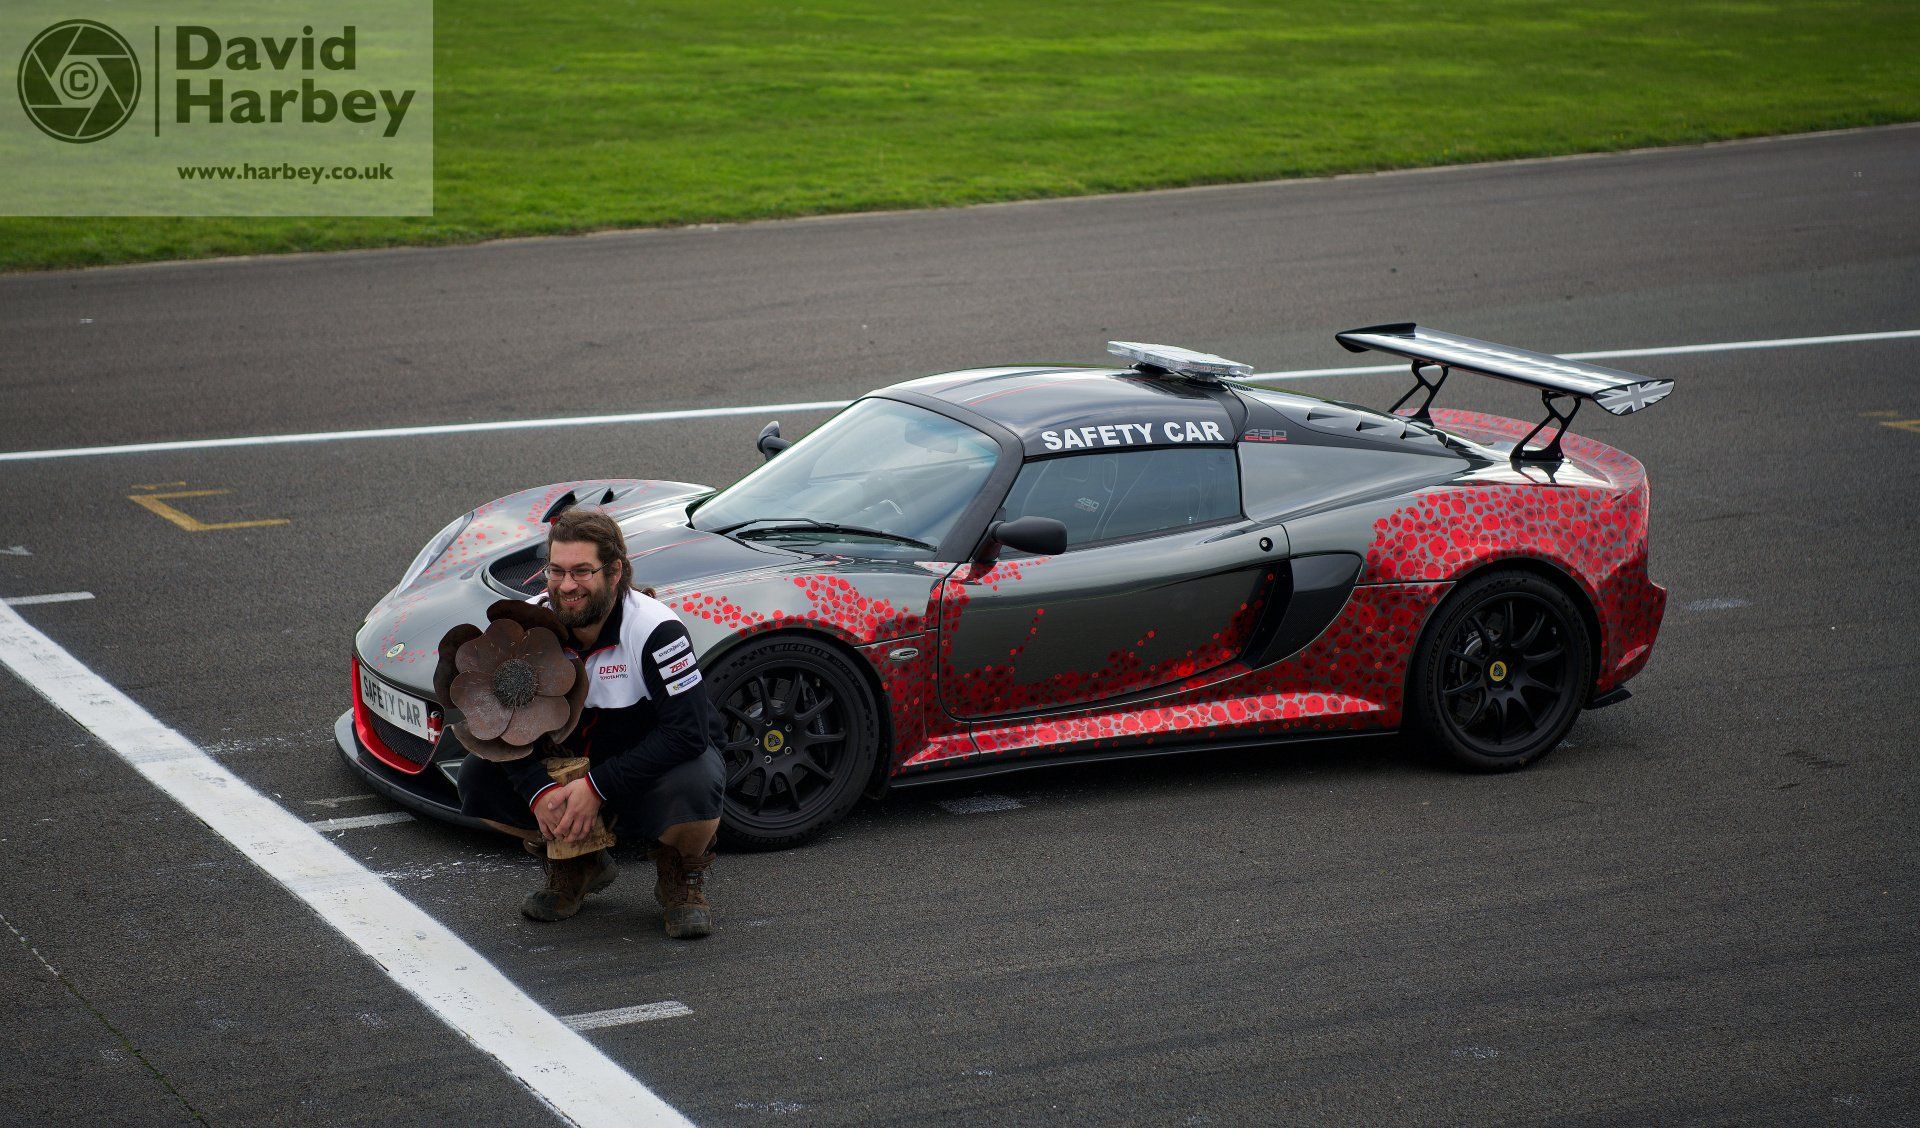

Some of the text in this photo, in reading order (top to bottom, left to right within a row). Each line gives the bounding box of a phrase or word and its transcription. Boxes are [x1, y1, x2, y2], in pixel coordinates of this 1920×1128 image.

[1041, 421, 1225, 450] SAFETY CAR
[670, 658, 689, 673] ZENT
[363, 675, 422, 727] SAFETY CAR
